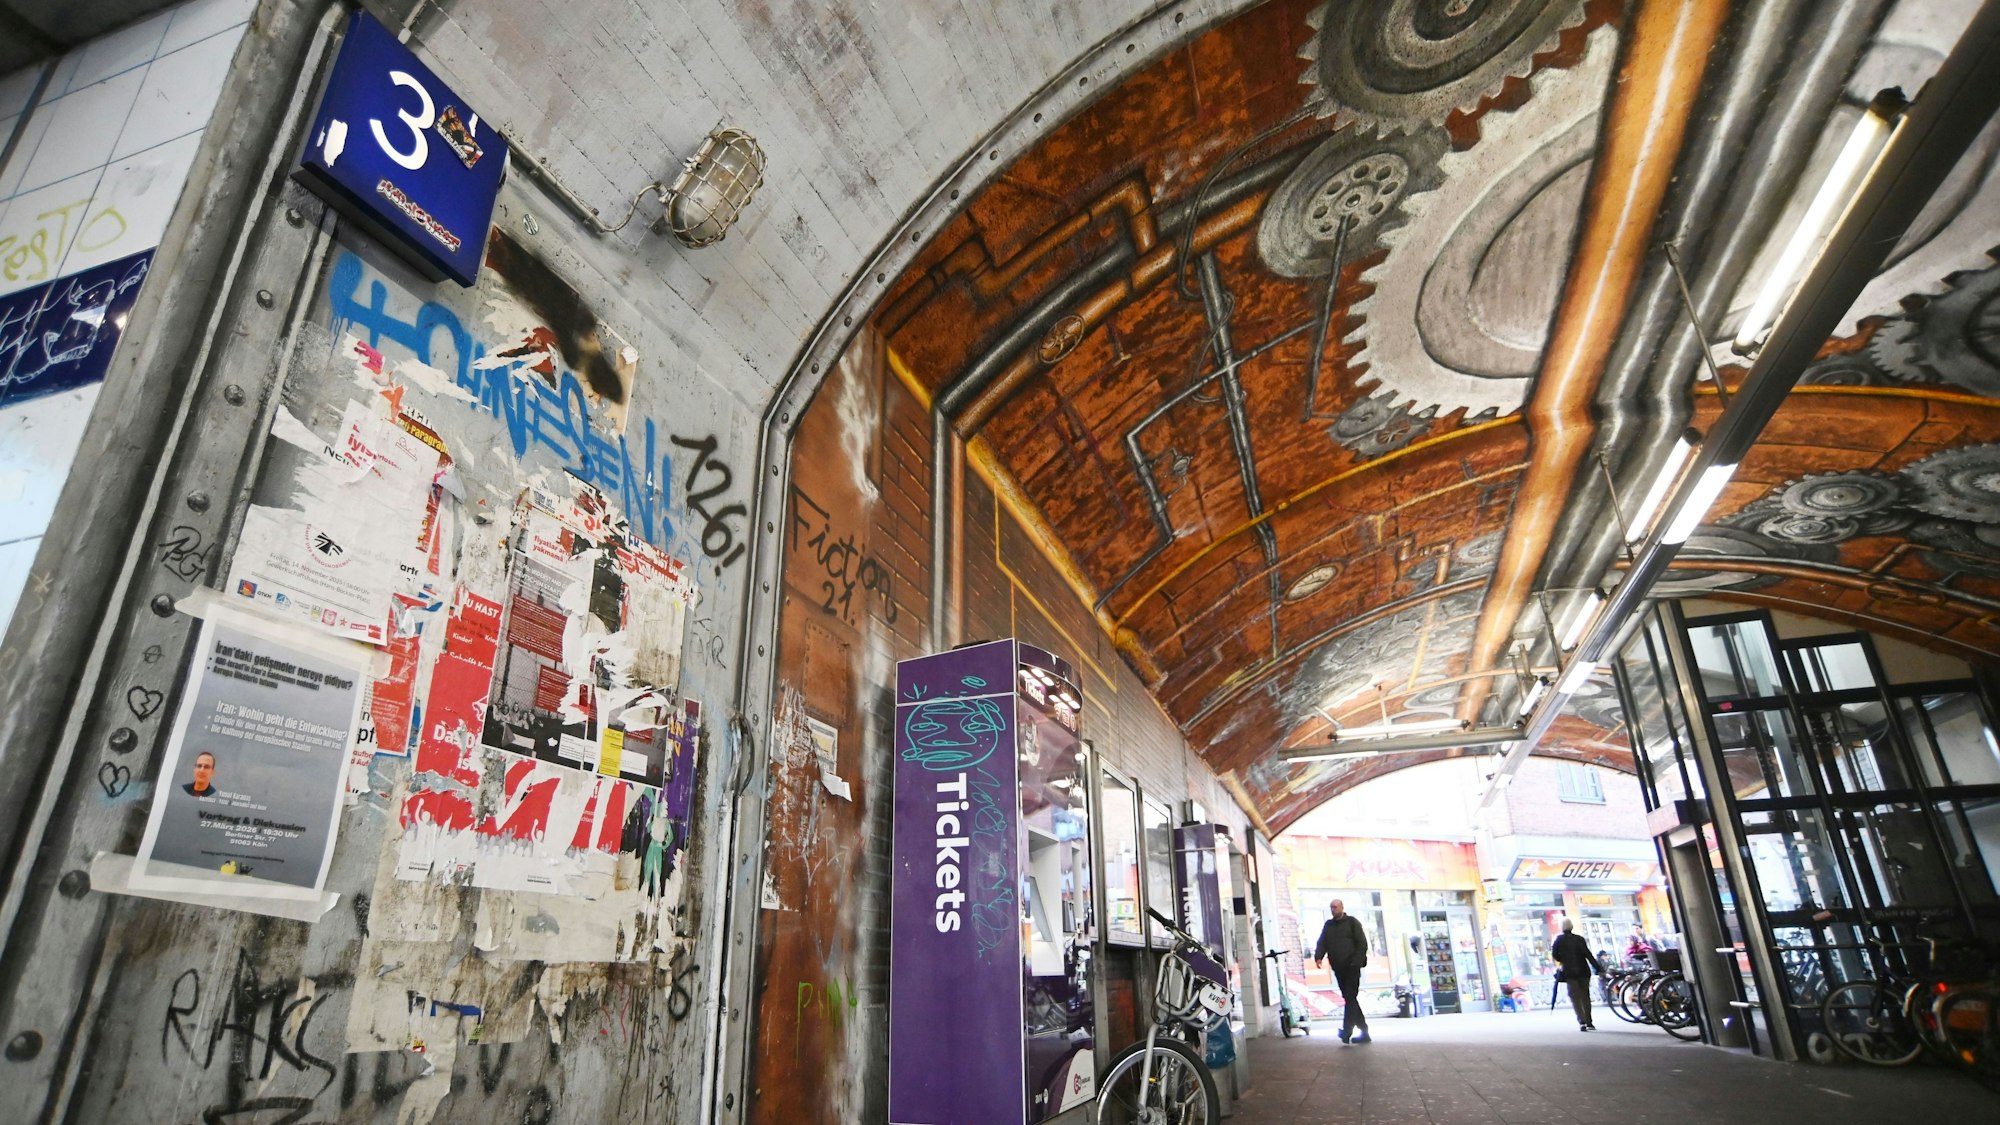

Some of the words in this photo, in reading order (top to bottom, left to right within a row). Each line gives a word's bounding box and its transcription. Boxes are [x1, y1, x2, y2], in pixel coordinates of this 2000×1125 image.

[369, 70, 436, 170] 3
[301, 565, 329, 580] November
[474, 602, 499, 618] HAST
[452, 632, 473, 644] Kinder!
[298, 665, 323, 682] nereye
[324, 673, 353, 690] gidiyor?
[216, 700, 237, 716] Iran:
[238, 705, 265, 722] Wohin
[266, 714, 284, 726] geht
[285, 717, 298, 729] die
[299, 719, 347, 741] Entwicklung?
[210, 724, 220, 733] Die
[245, 731, 254, 740] der
[198, 810, 240, 824] Vortrag
[242, 816, 250, 825] &
[252, 817, 306, 833] Diskussion
[200, 820, 234, 832] 27.März
[263, 828, 284, 837] 18:30
[285, 830, 300, 839] Uhr
[224, 831, 253, 841] Berliner
[254, 833, 267, 841] Str.
[252, 840, 268, 848] Köln
[935, 772, 970, 933] Tickets
[1562, 862, 1616, 879] GIZEH
[1208, 992, 1220, 1004] KVB
